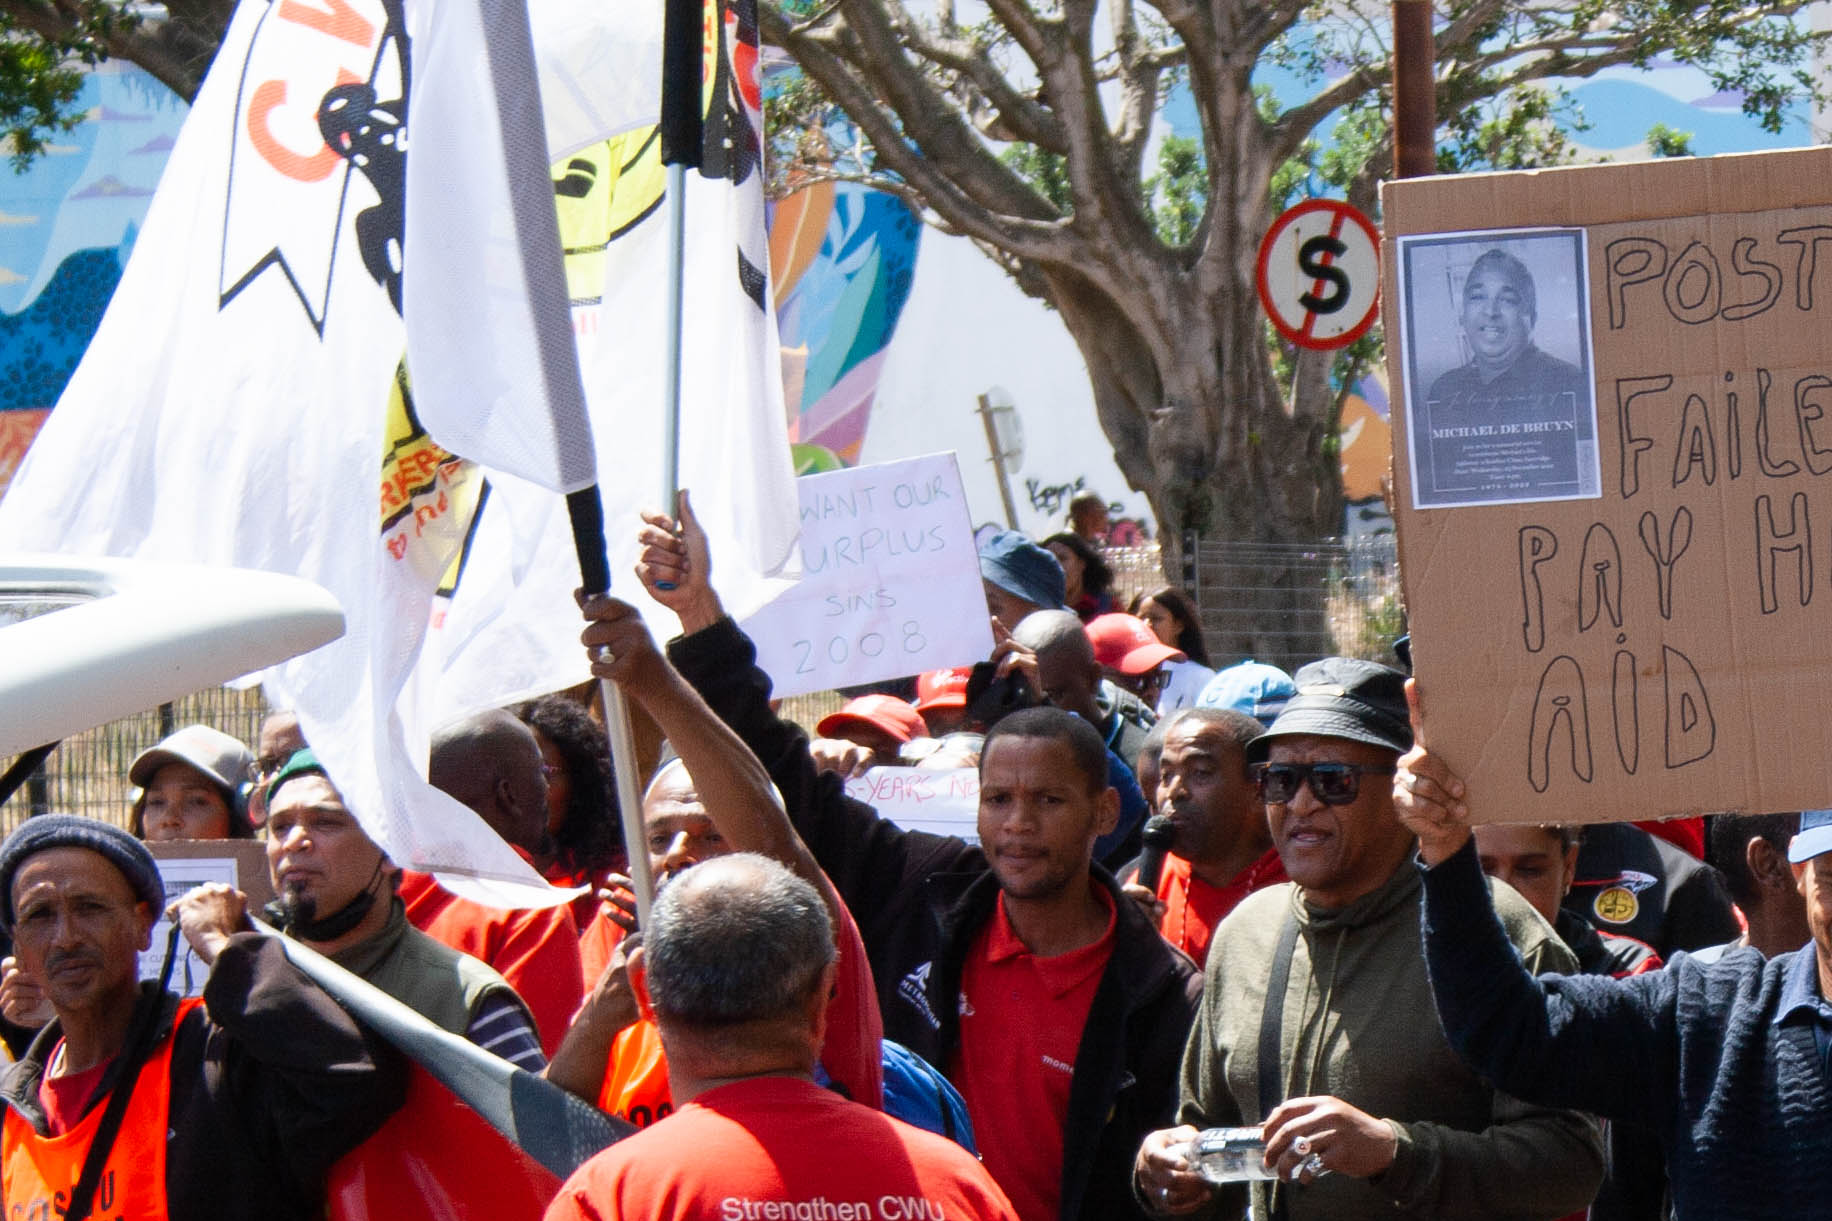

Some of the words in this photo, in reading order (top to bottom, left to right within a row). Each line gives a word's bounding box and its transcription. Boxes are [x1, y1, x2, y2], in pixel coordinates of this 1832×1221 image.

[1432, 424, 1498, 439] MICHAEL
[1501, 422, 1521, 435] DE
[1524, 420, 1575, 433] BRUYN
[800, 486, 877, 521] WANT
[893, 475, 951, 509] OUR
[801, 525, 945, 574] URPLUS
[1518, 506, 1694, 653] PAY
[792, 620, 927, 675] 2008
